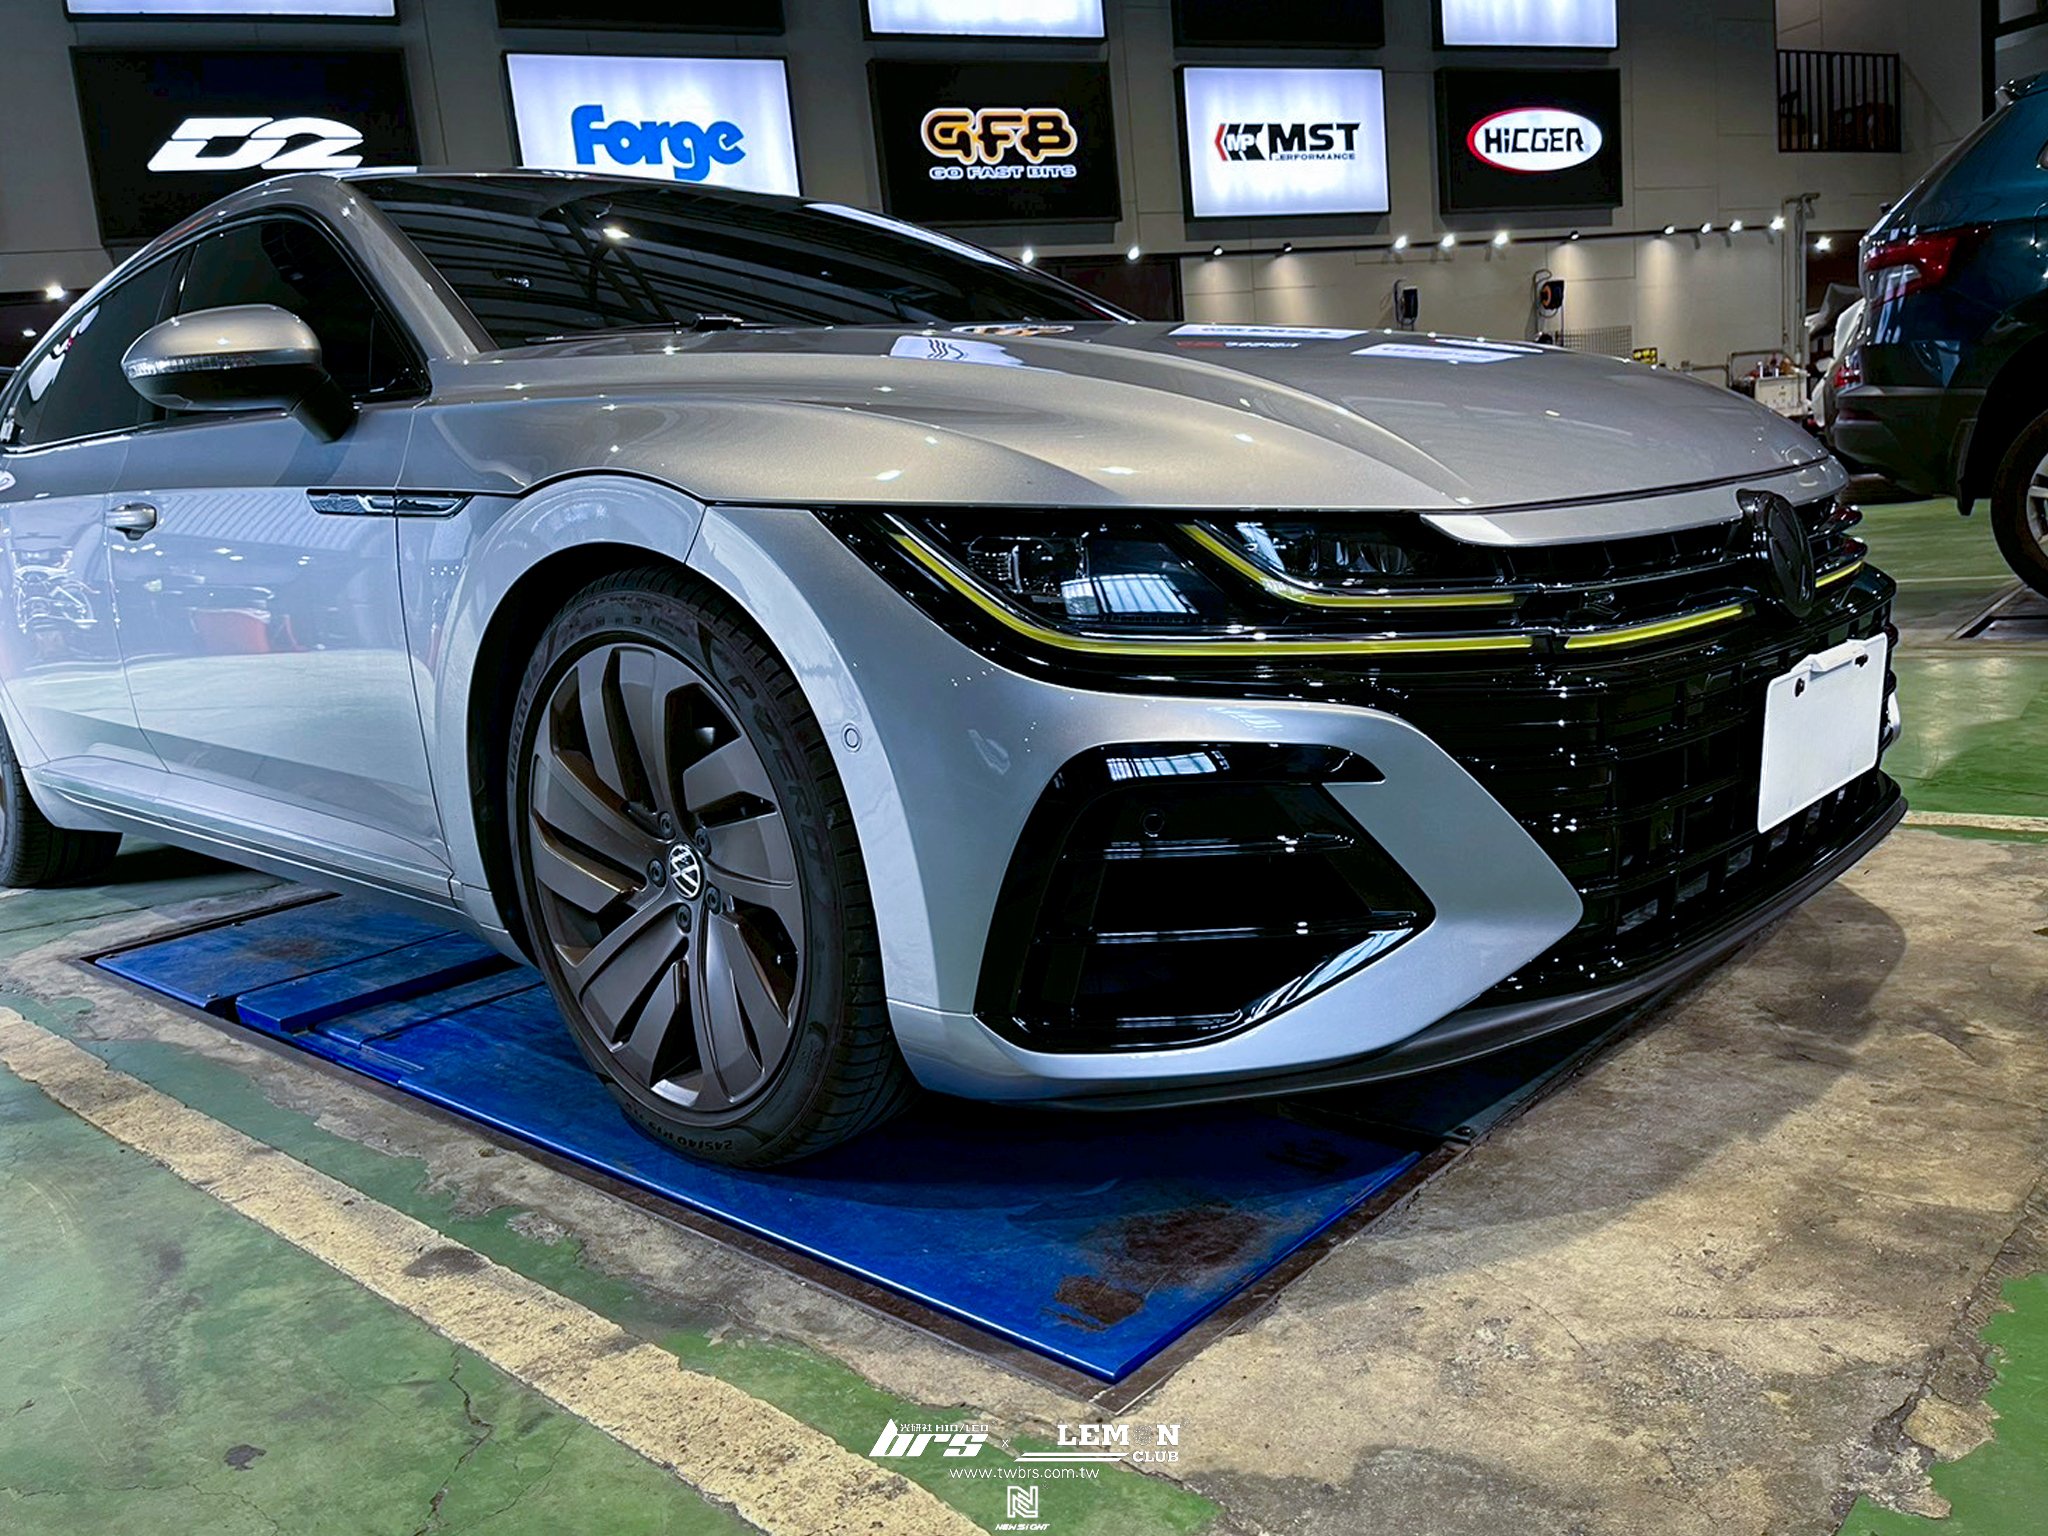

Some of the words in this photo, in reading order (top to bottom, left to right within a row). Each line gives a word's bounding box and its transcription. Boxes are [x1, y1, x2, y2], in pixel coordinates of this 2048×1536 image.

[921, 108, 1077, 165] GFB
[1268, 123, 1361, 152] MST
[930, 167, 963, 179] GO
[967, 166, 1024, 179] FAST
[1027, 165, 1077, 178] BITS
